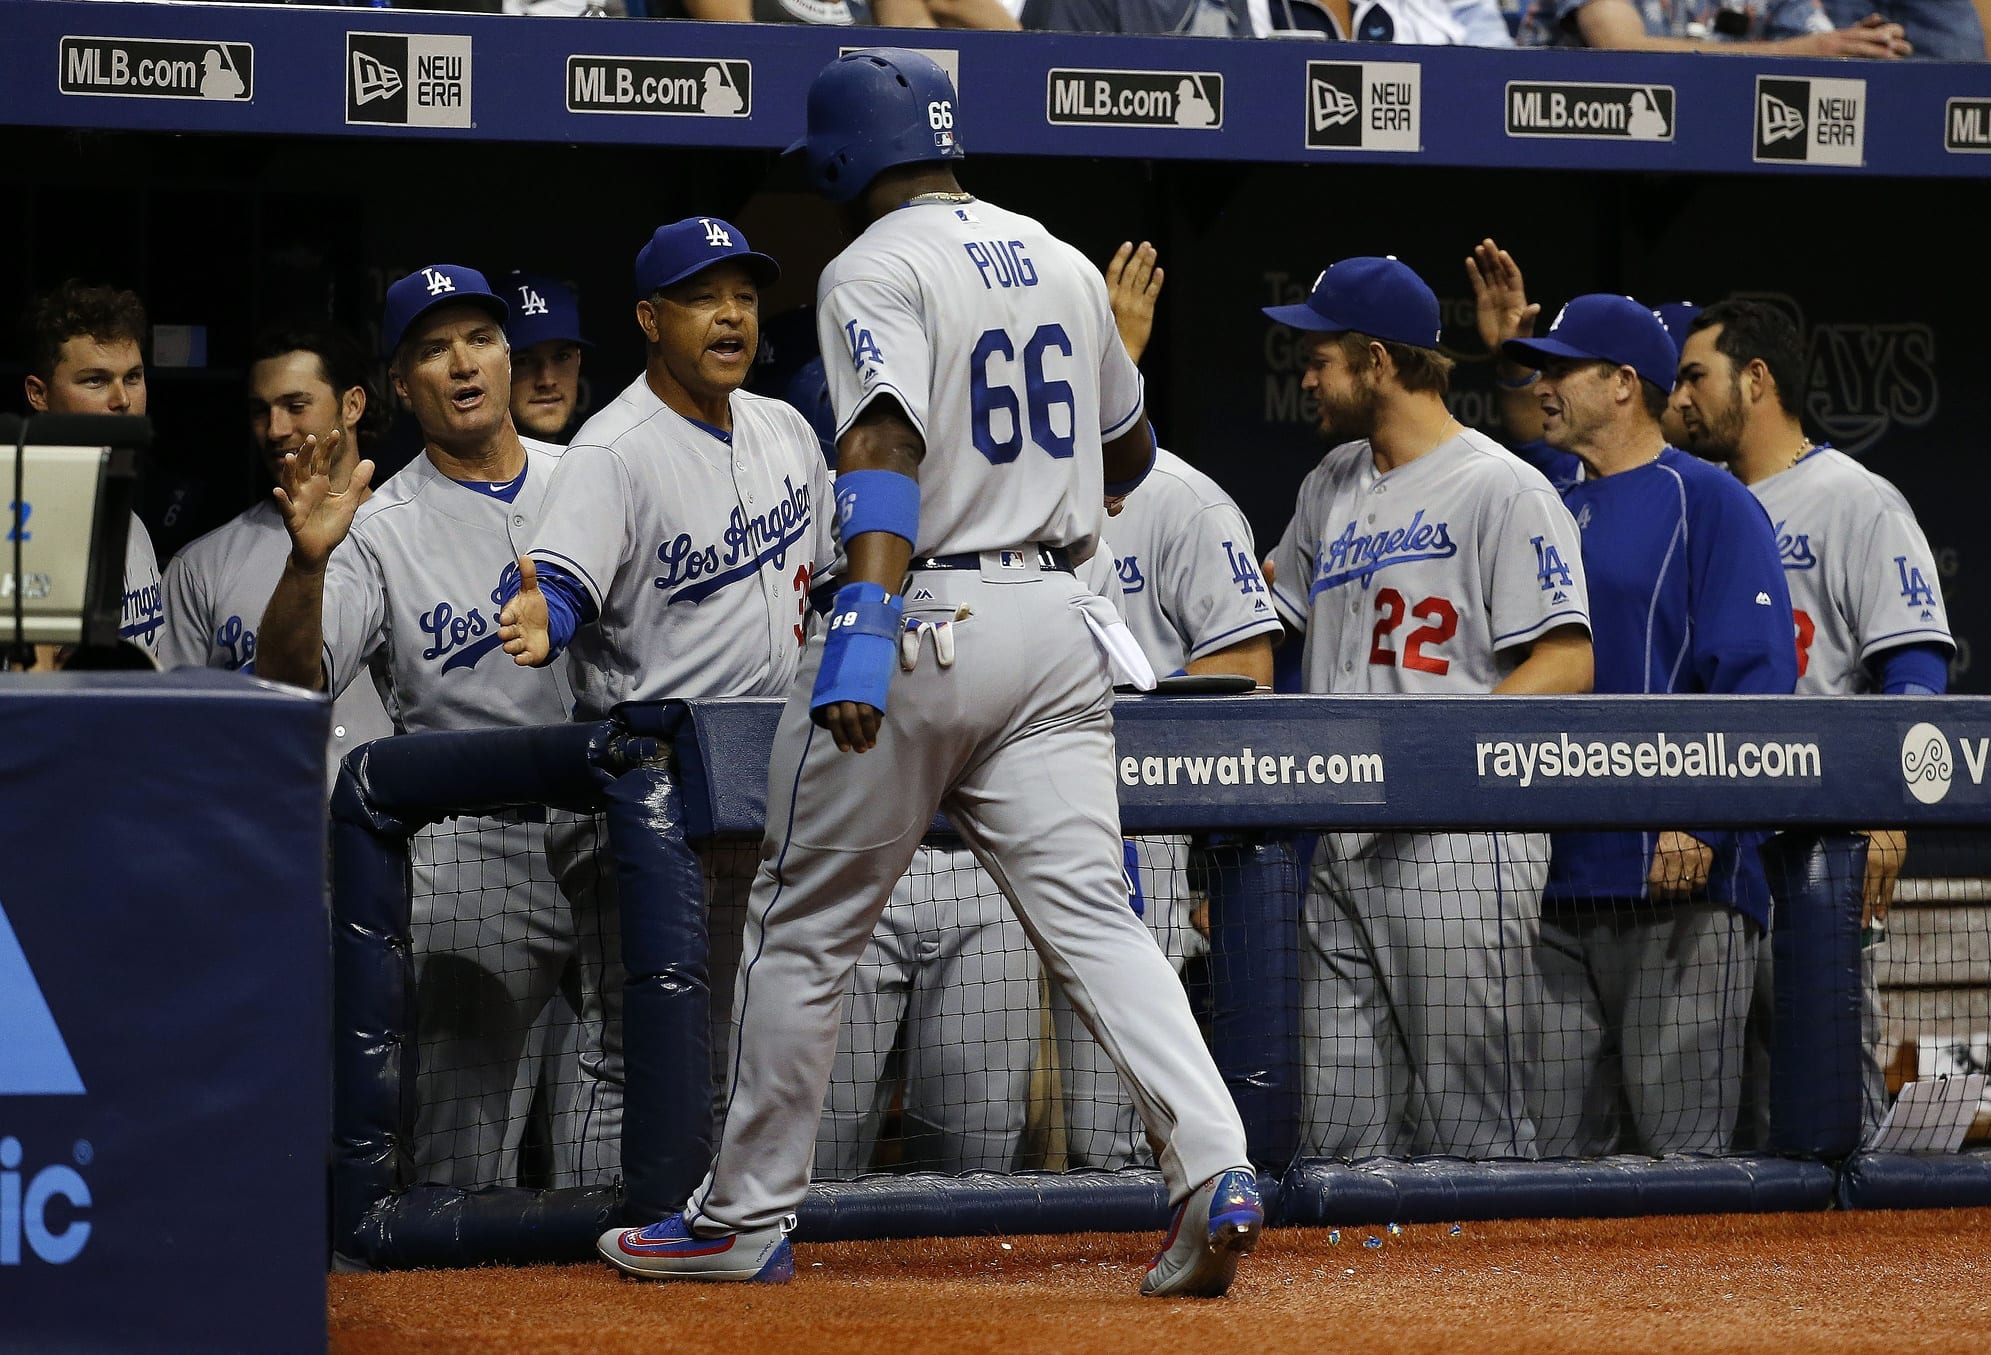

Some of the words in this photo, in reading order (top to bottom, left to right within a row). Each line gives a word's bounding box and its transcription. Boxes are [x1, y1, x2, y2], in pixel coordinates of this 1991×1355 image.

[68, 47, 196, 88] MLB.com
[418, 56, 461, 80] NEW
[575, 66, 698, 105] MLB.com
[418, 82, 461, 106] ERA
[1055, 79, 1172, 117] MLB.com
[1372, 82, 1411, 105] NEW
[1512, 91, 1625, 130] MLB.com
[1817, 97, 1856, 121] NEW
[928, 101, 953, 129] 66
[1372, 107, 1411, 131] ERA
[1816, 123, 1854, 145] ERA
[1953, 108, 1991, 143] ML
[698, 218, 733, 247] LA
[421, 268, 455, 296] LA
[963, 240, 1038, 289] PUIG
[518, 286, 549, 316] LA
[844, 319, 884, 374] LA
[970, 322, 1075, 465] 66
[7, 501, 32, 541] 2
[654, 533, 719, 589] Los
[1222, 541, 1264, 594] LA
[1323, 509, 1457, 589] Angeles
[1530, 536, 1573, 590] LA
[1894, 556, 1936, 607] LA
[217, 615, 256, 670] Lo
[420, 602, 487, 660] Los
[1368, 587, 1458, 676] 22
[1476, 732, 1821, 787] raysbaseball.com
